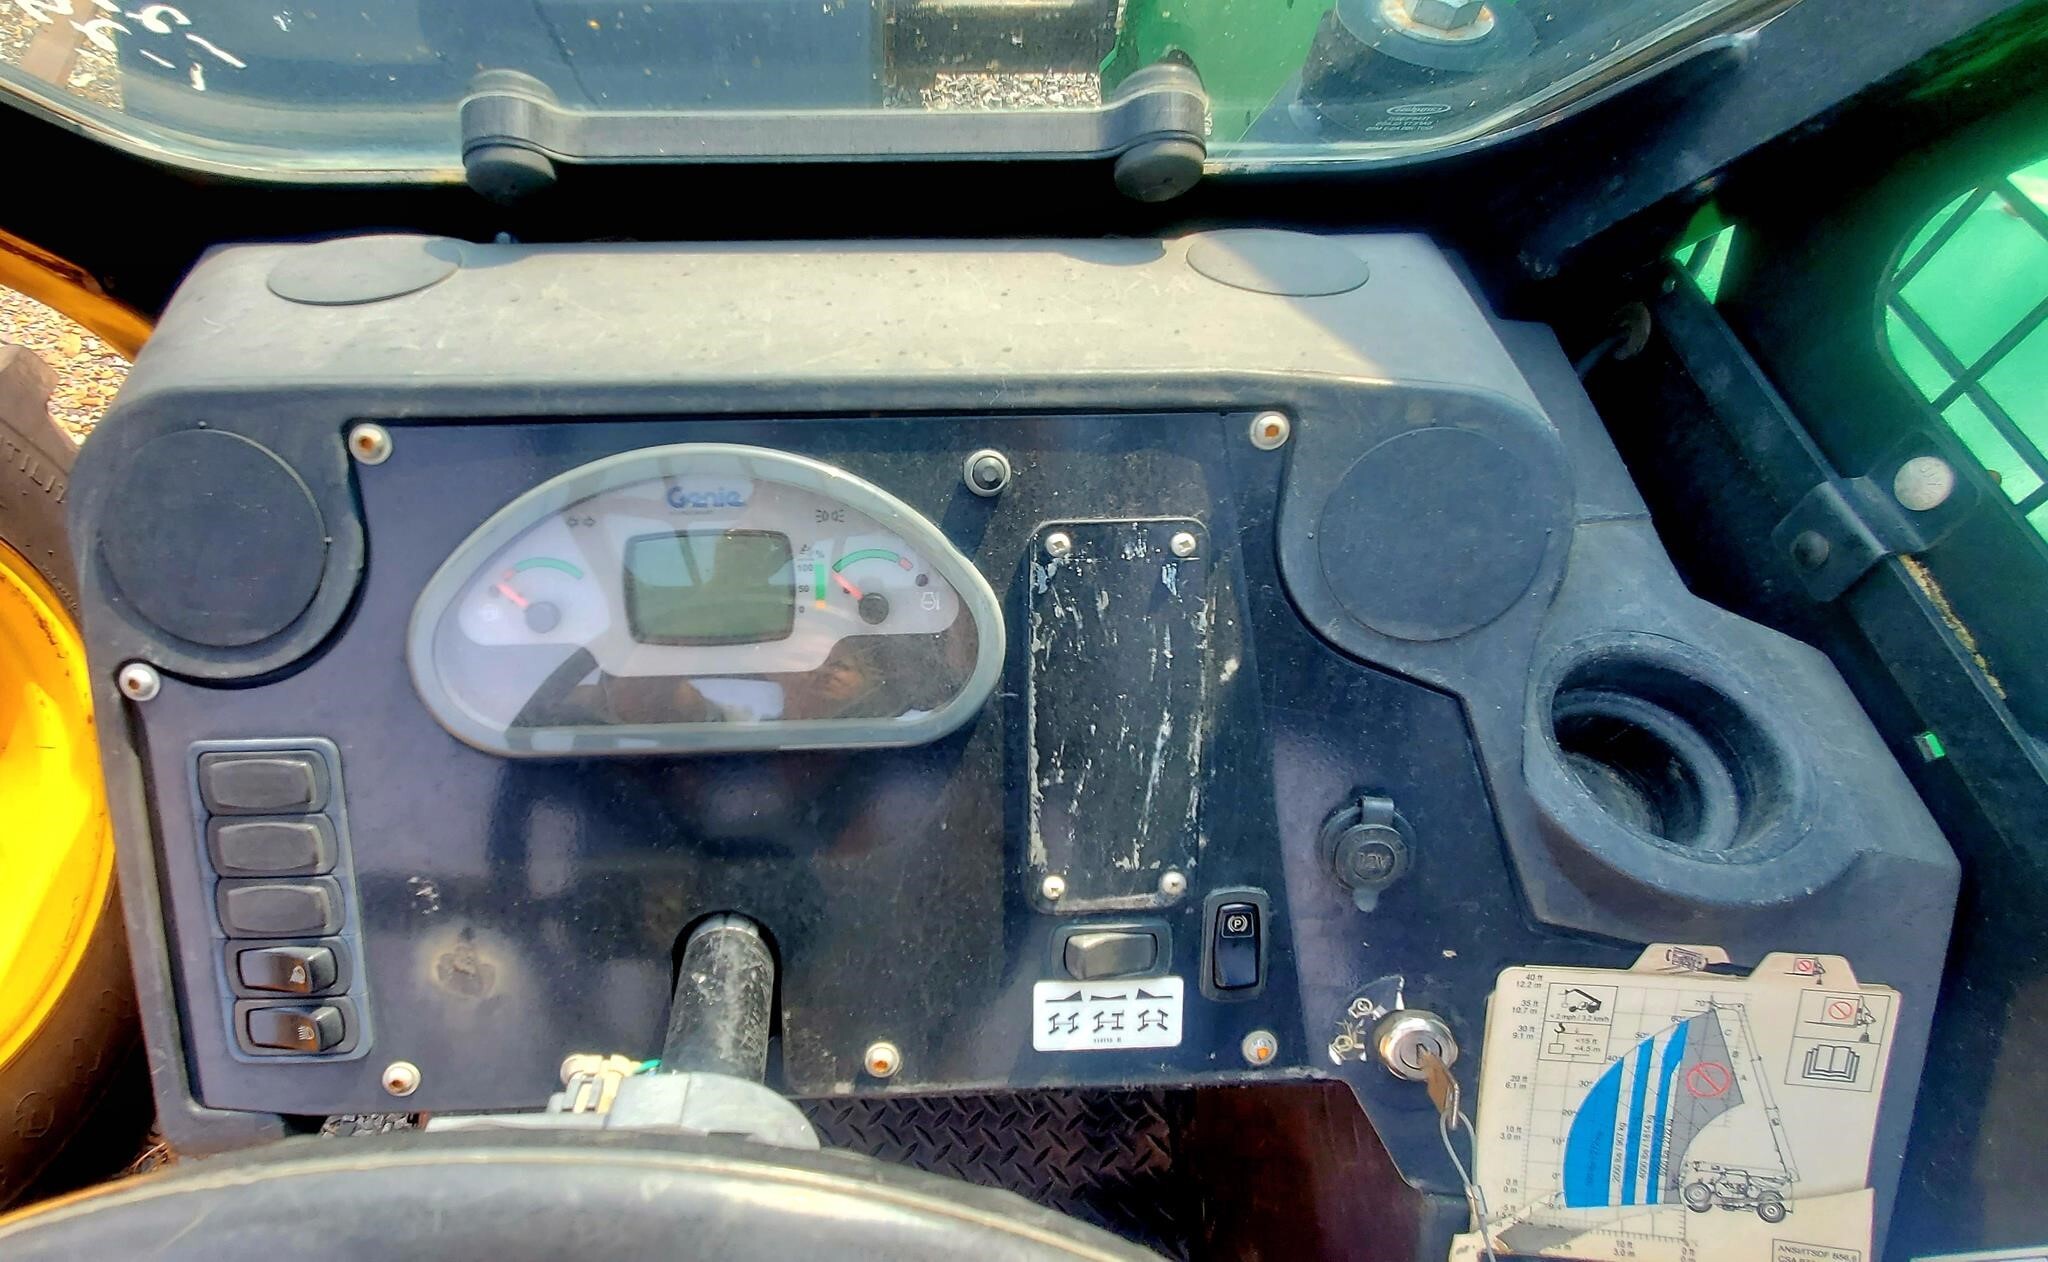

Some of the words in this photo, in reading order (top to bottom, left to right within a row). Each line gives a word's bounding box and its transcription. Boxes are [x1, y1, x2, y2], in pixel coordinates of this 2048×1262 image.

[667, 486, 745, 508] Genie
[798, 564, 813, 572] 100
[799, 584, 809, 592] 50
